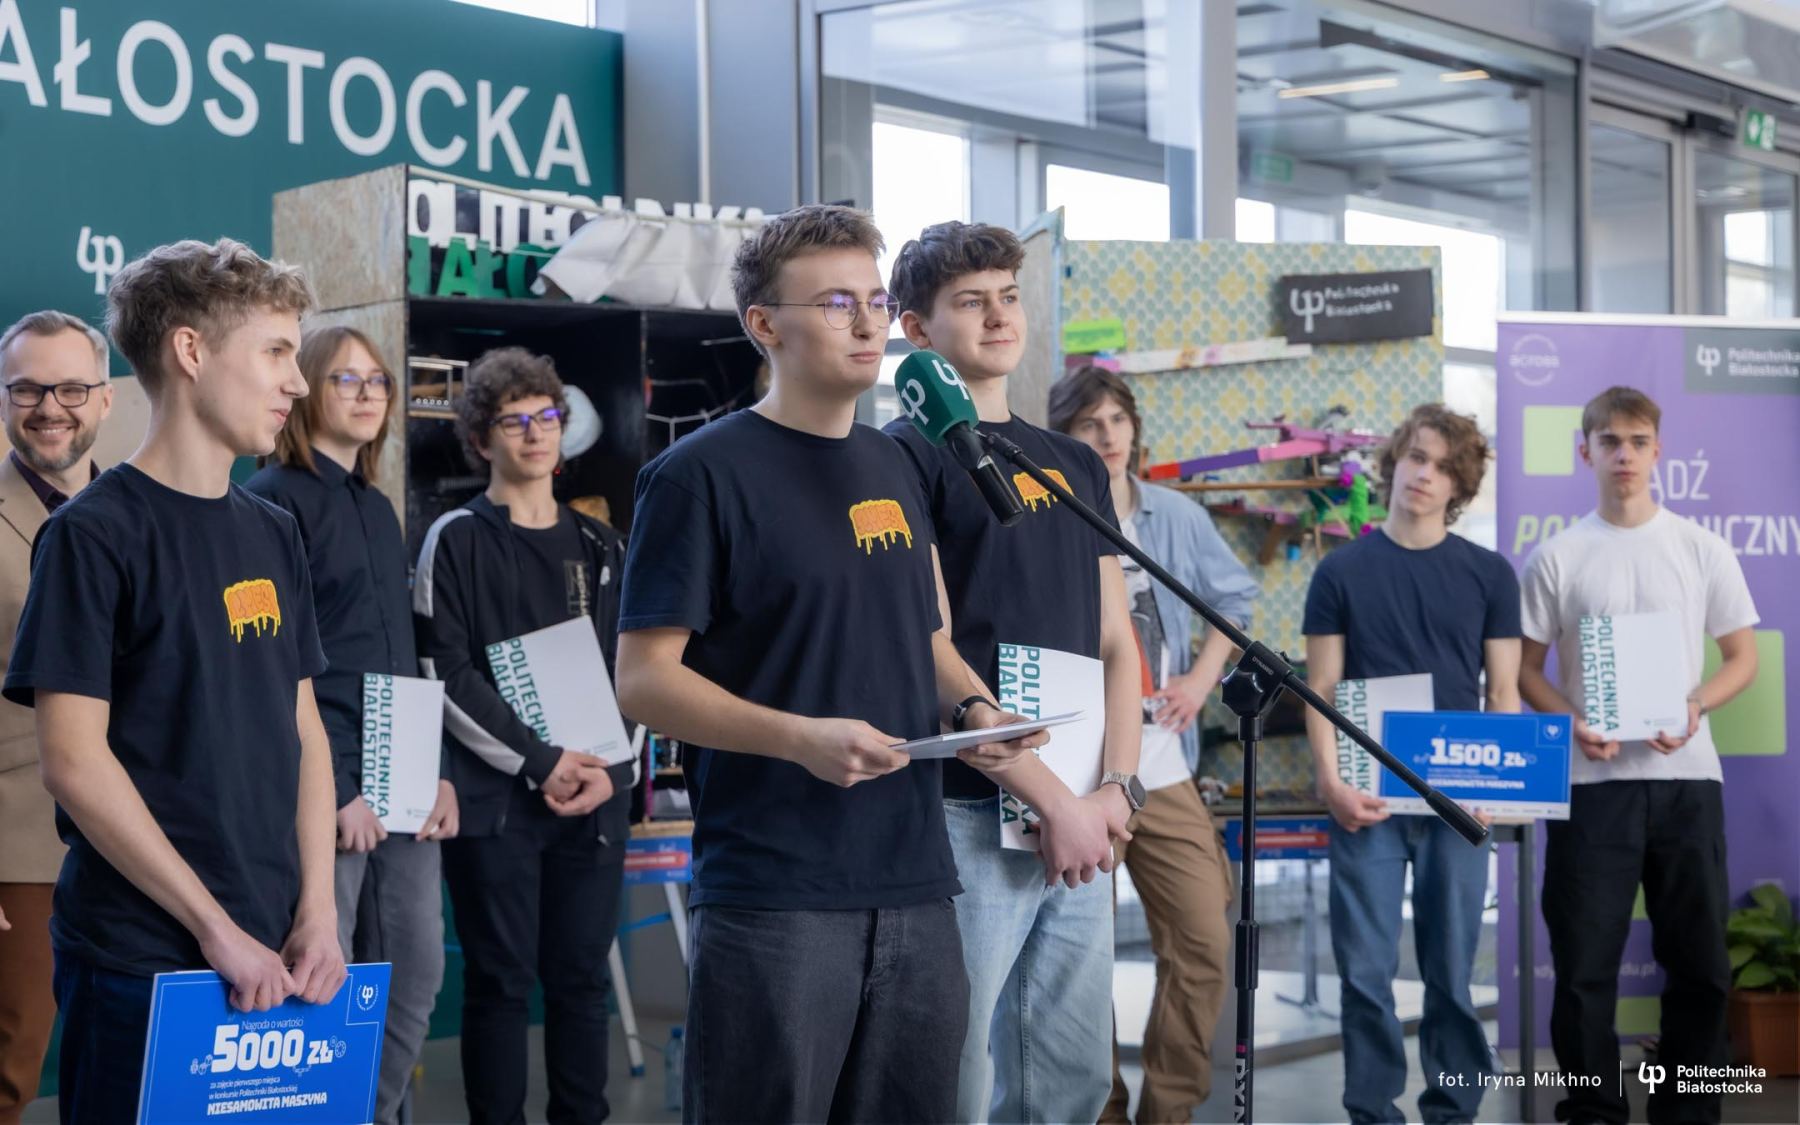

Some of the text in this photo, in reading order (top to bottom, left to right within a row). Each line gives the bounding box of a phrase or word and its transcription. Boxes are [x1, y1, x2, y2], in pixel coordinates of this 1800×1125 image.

[505, 637, 553, 745] POLITECHN
[1580, 615, 1600, 727] BIAŁOSTOCKA
[1598, 614, 1619, 732] POLITECHNIKA
[377, 674, 393, 818] POLITECHNIKA
[1352, 679, 1371, 792] POLITHNIK
[1430, 738, 1501, 766] 1500
[211, 1024, 304, 1073] 5000
[242, 1019, 271, 1032] Nagroda
[277, 1016, 304, 1028] wartości
[207, 1092, 327, 1116] NIESAMOWITA MASZYNA
